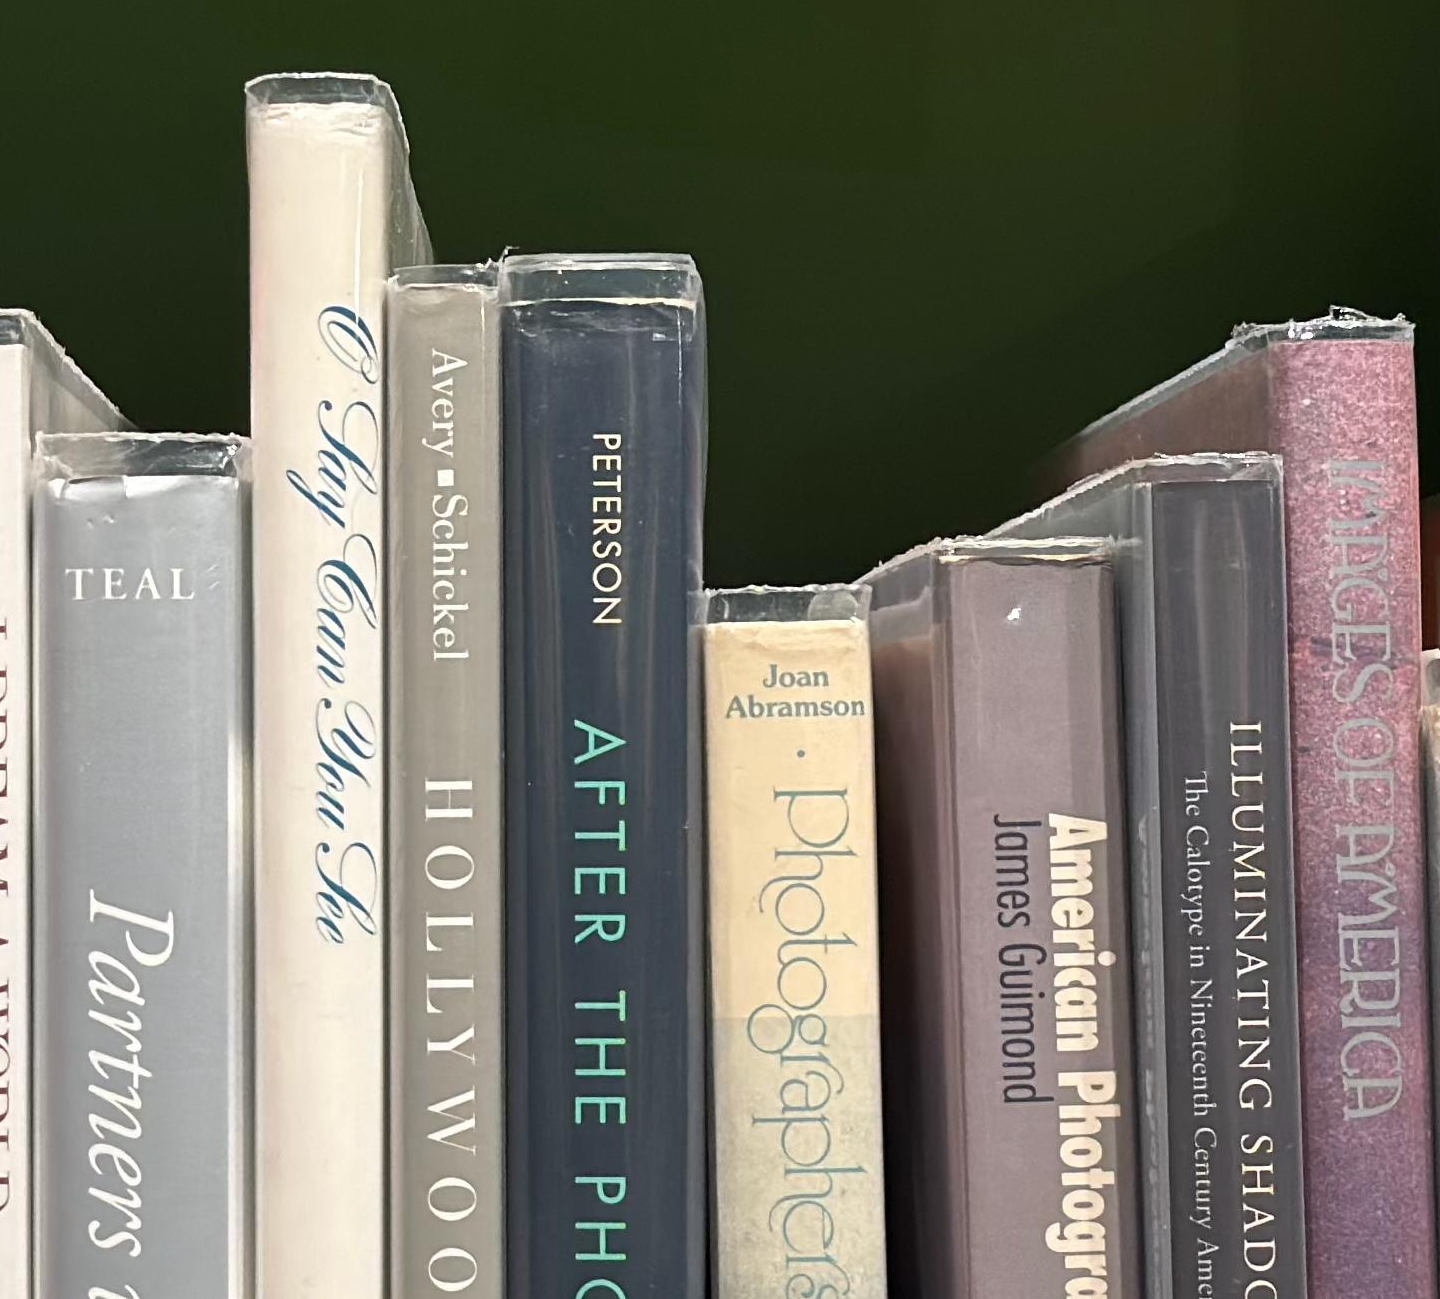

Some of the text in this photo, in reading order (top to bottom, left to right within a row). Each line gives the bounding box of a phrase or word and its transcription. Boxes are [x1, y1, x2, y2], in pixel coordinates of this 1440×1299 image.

[65, 567, 196, 601] TEAL
[422, 350, 470, 661] Avery Schickel
[591, 433, 623, 624] PETERSON
[725, 695, 865, 719] Abramson
[763, 664, 829, 688] Joan
[573, 718, 627, 944] AFTER
[1048, 813, 1116, 1052] American
[1228, 720, 1274, 1113] ILLUMINATING
[573, 990, 627, 1124] THE
[993, 814, 1053, 1104] James Guimond
[87, 889, 175, 1257] Partners
